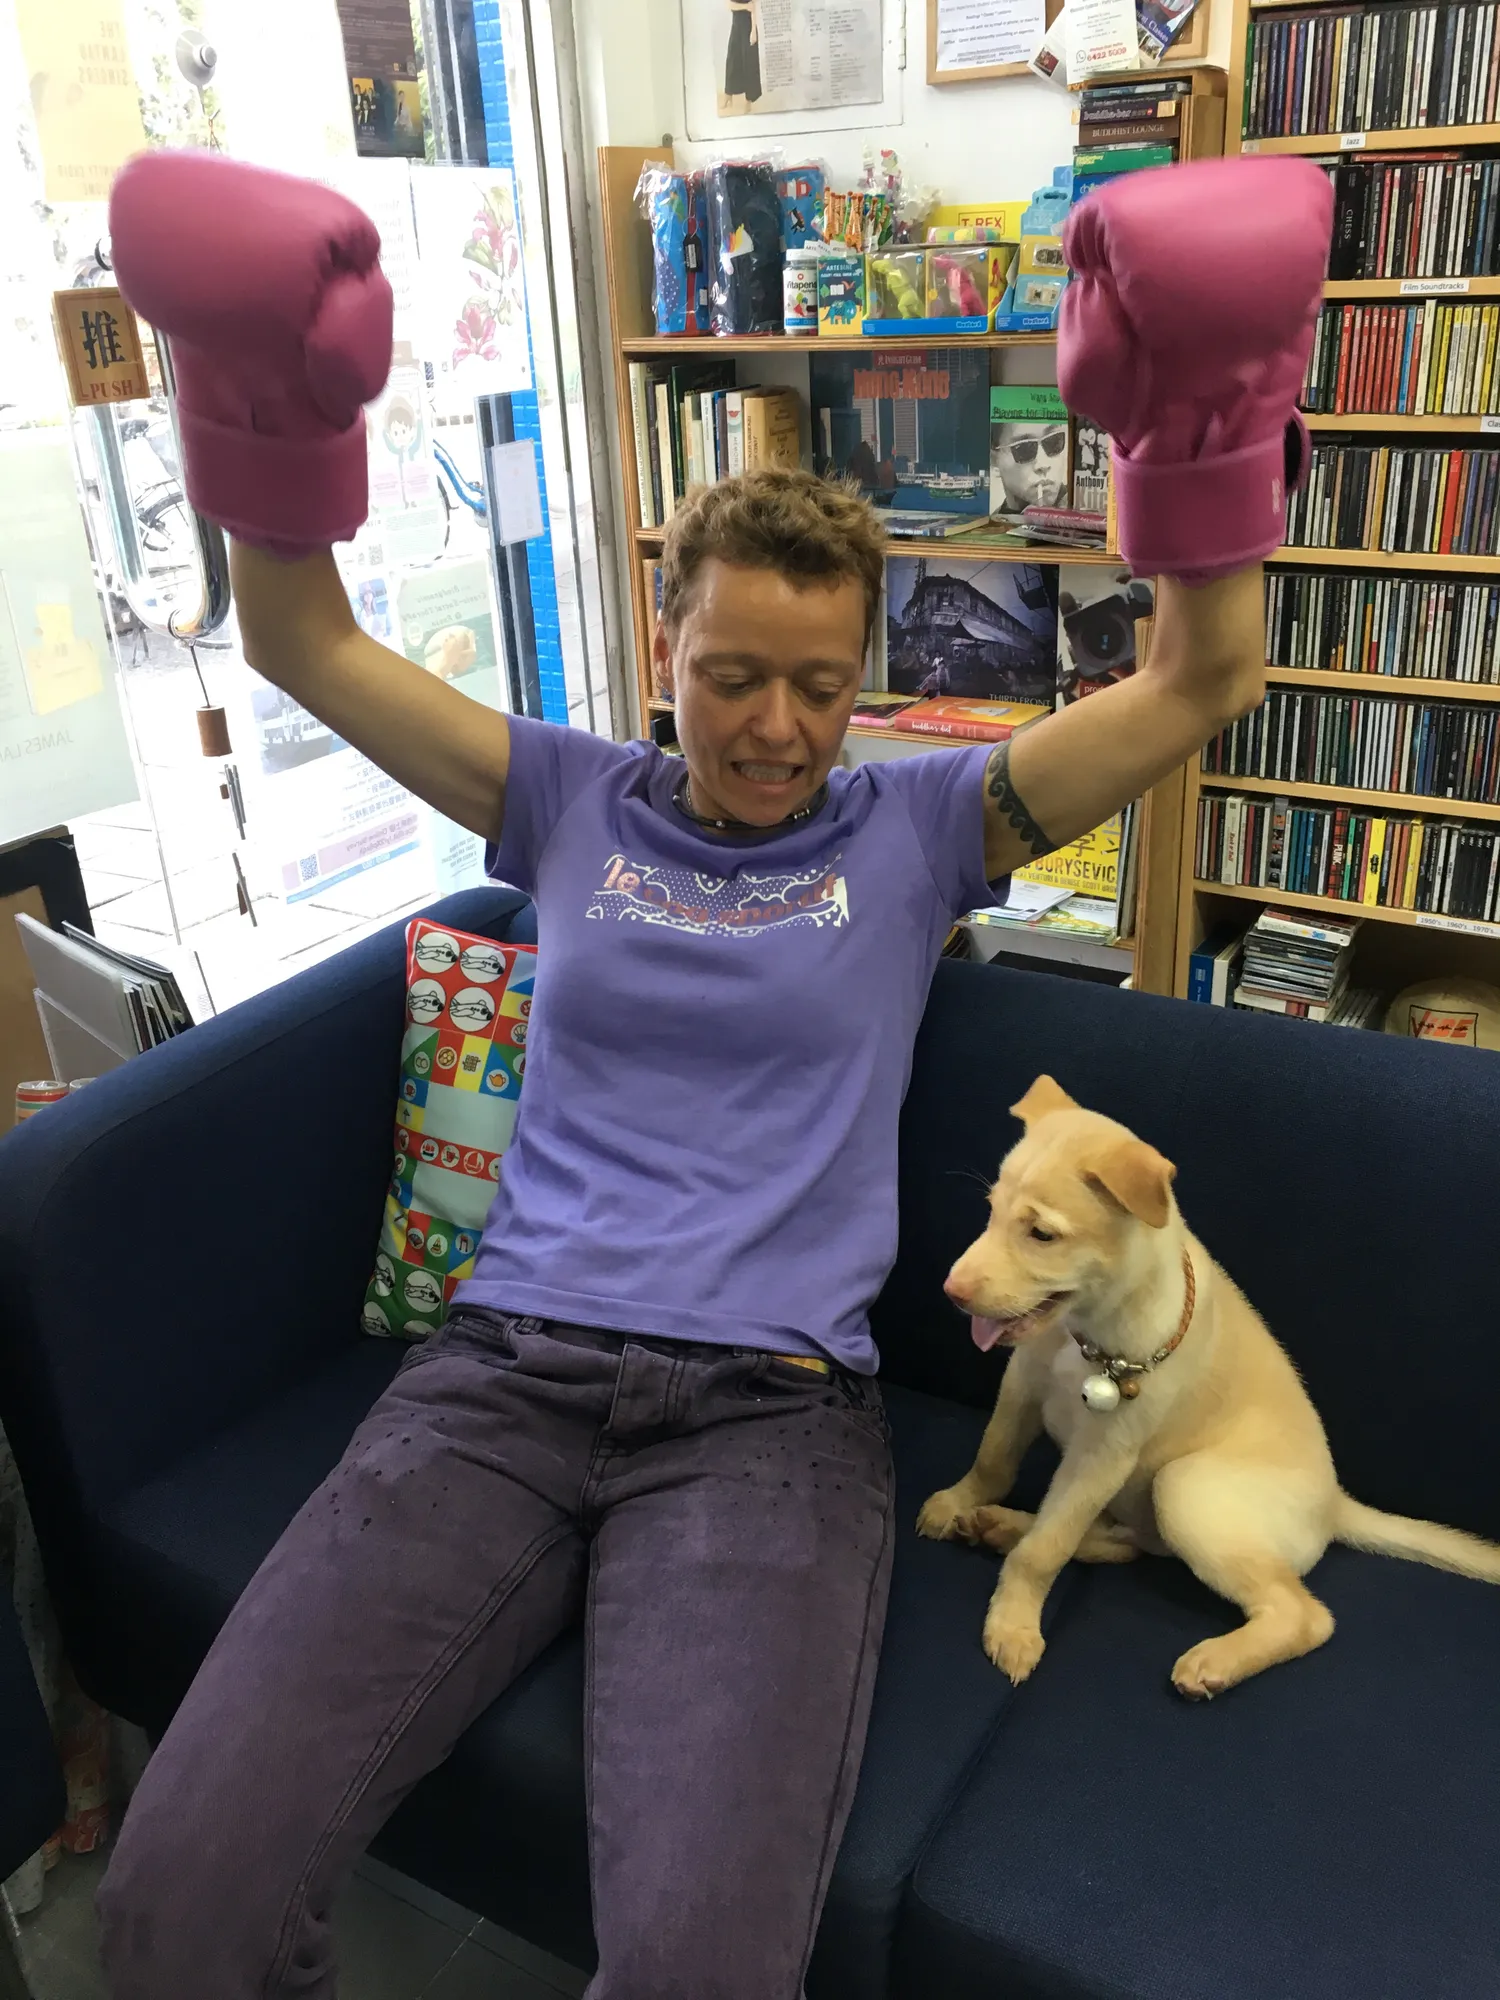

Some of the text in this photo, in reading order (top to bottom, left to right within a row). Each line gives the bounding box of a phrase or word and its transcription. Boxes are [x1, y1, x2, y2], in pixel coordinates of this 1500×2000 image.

[1132, 124, 1165, 135] LOUNGE
[1346, 138, 1360, 146] Jazz
[1343, 208, 1354, 240] CHESS
[1403, 282, 1465, 291] Film Soundtracks
[80, 308, 125, 371] 推
[89, 382, 134, 398] PUSH
[1026, 408, 1038, 417] for
[1075, 475, 1105, 490] Anthony
[989, 693, 1052, 708] THIRD FRONT
[911, 720, 952, 733] buddha's diet
[1332, 843, 1344, 866] PUNK
[603, 856, 642, 893] le
